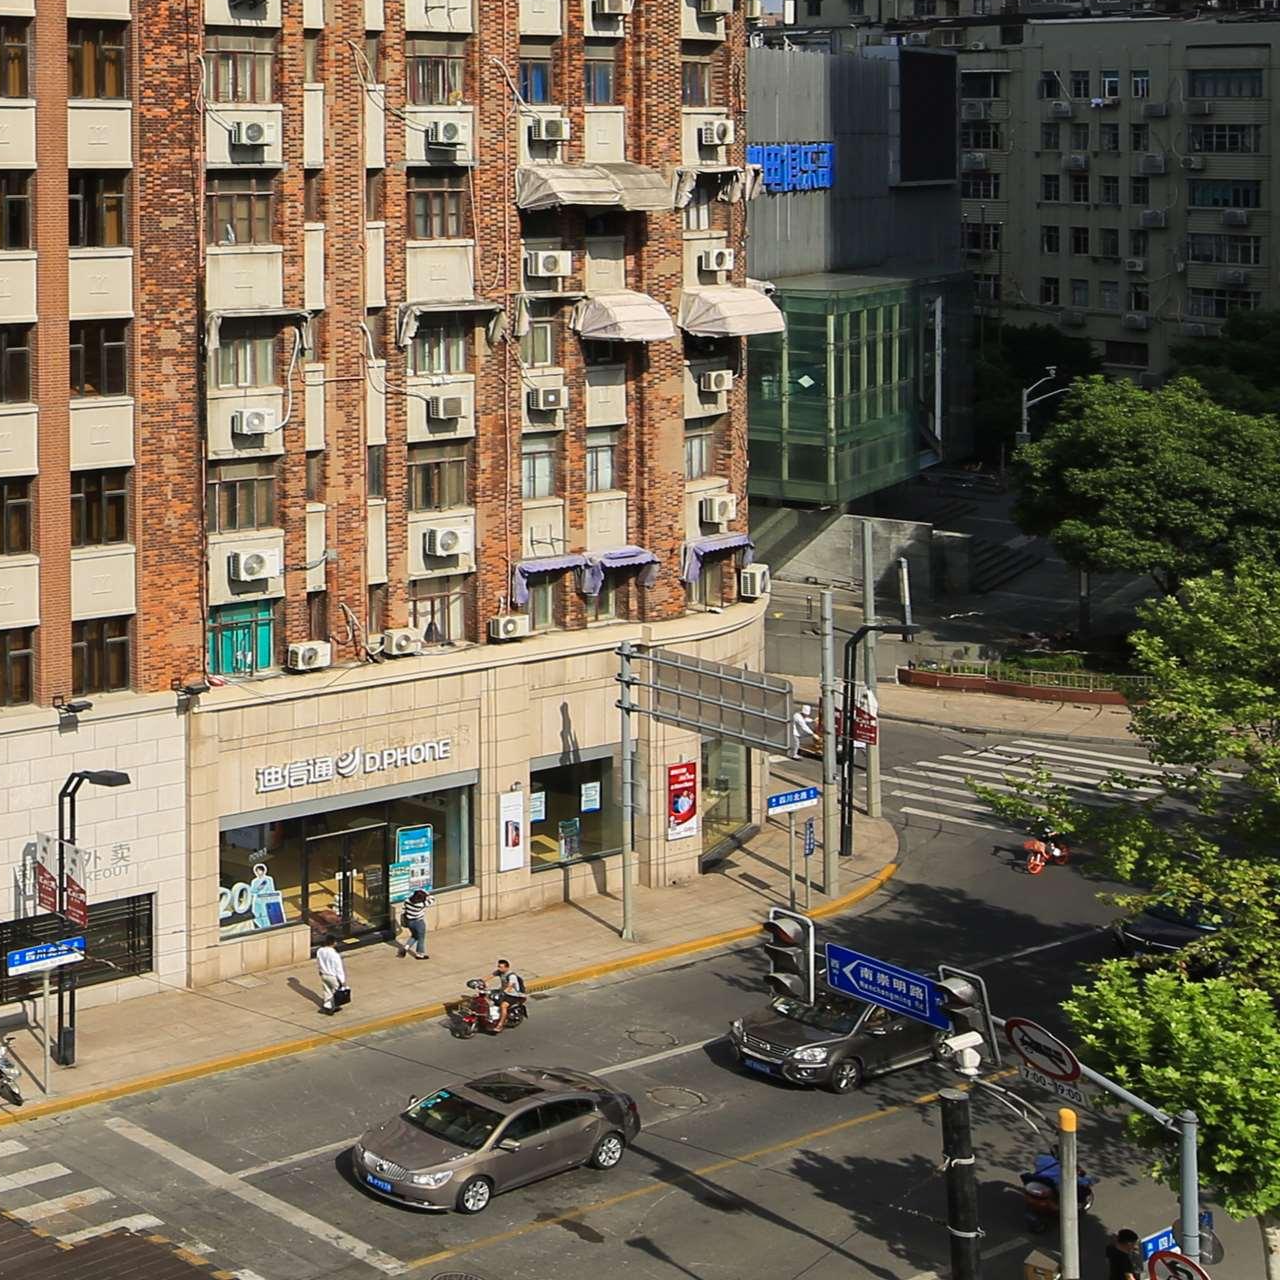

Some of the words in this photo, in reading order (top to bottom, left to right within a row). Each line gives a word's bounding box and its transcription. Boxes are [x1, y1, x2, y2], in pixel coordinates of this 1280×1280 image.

[364, 737, 452, 774] D.PHONE
[256, 757, 333, 793] 迪信通
[859, 966, 924, 1000] 南崇明路
